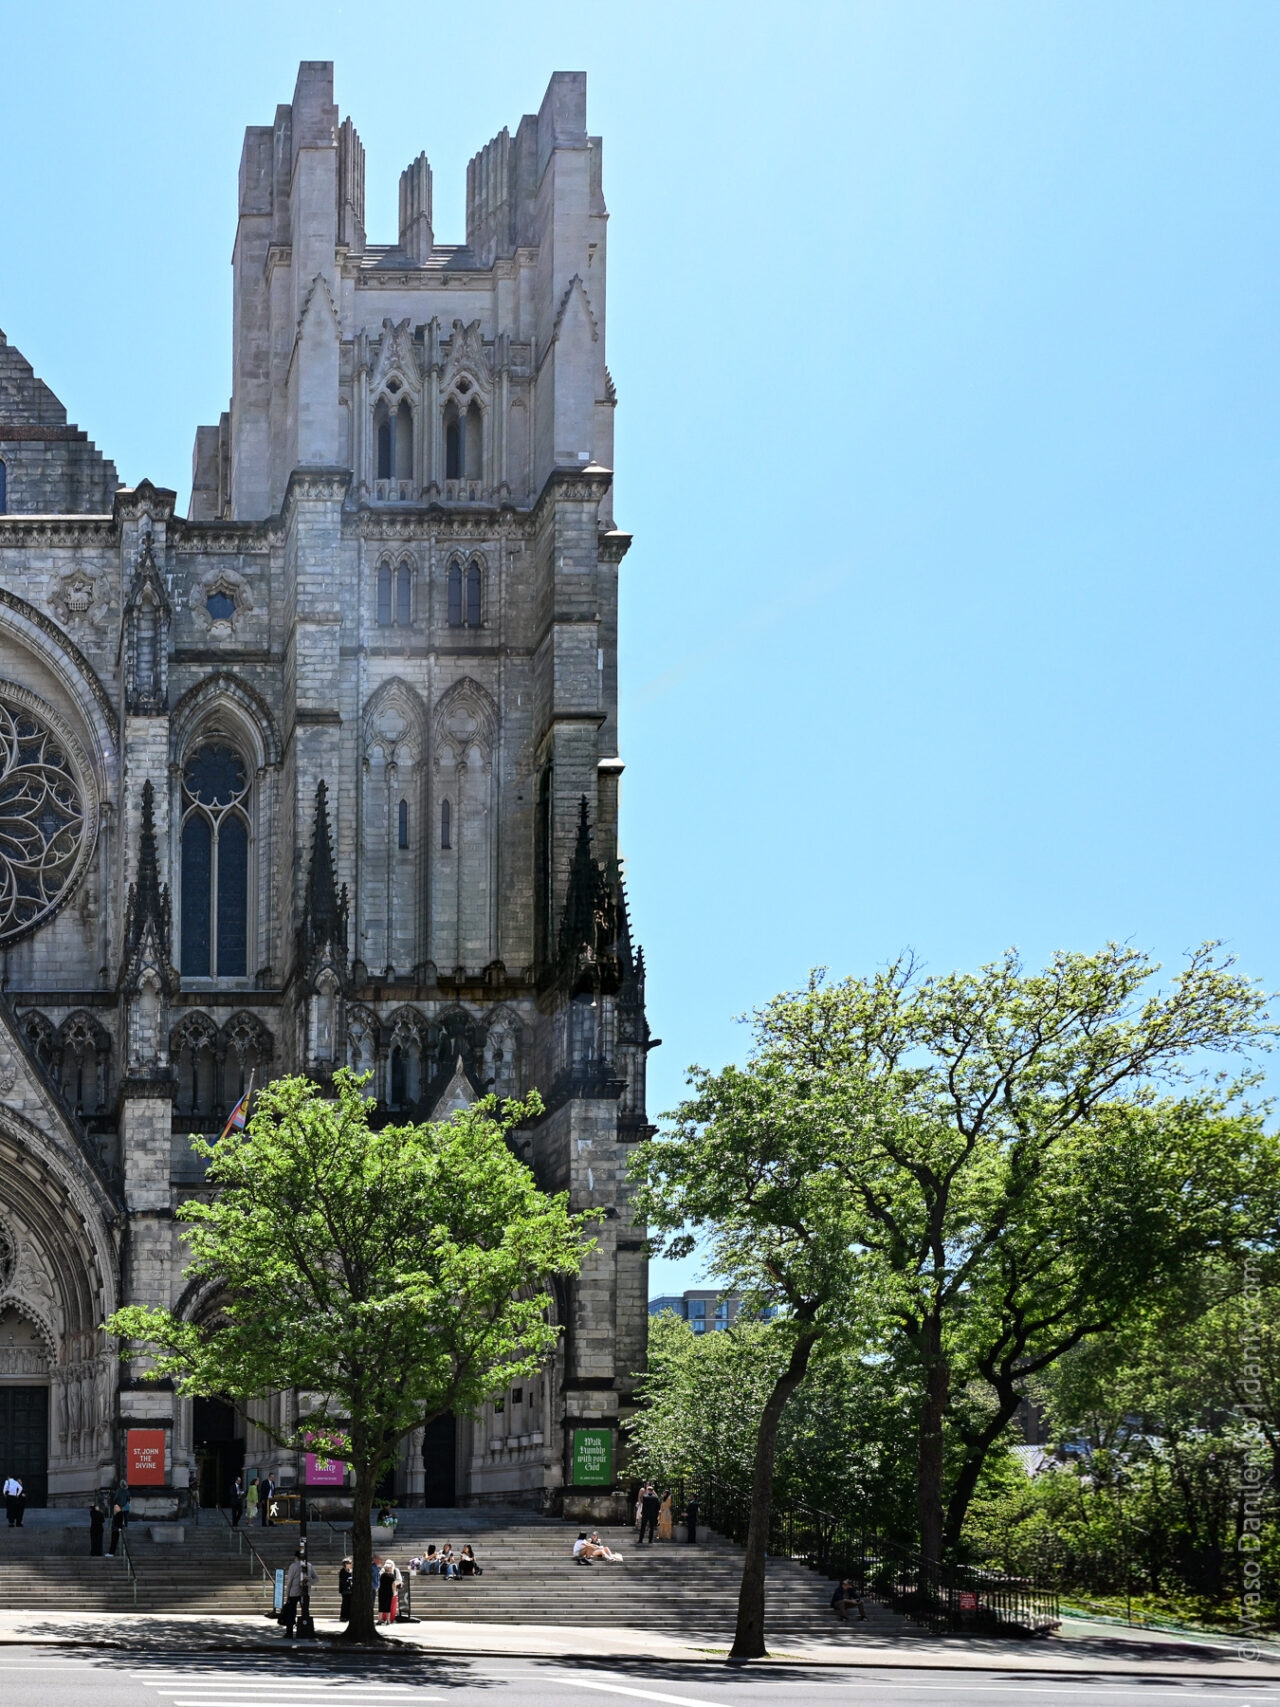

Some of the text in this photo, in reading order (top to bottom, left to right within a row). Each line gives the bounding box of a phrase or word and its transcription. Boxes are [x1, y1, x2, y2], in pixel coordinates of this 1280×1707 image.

[584, 1437, 601, 1446] Walk
[577, 1454, 607, 1464] with your
[584, 1463, 600, 1472] God
